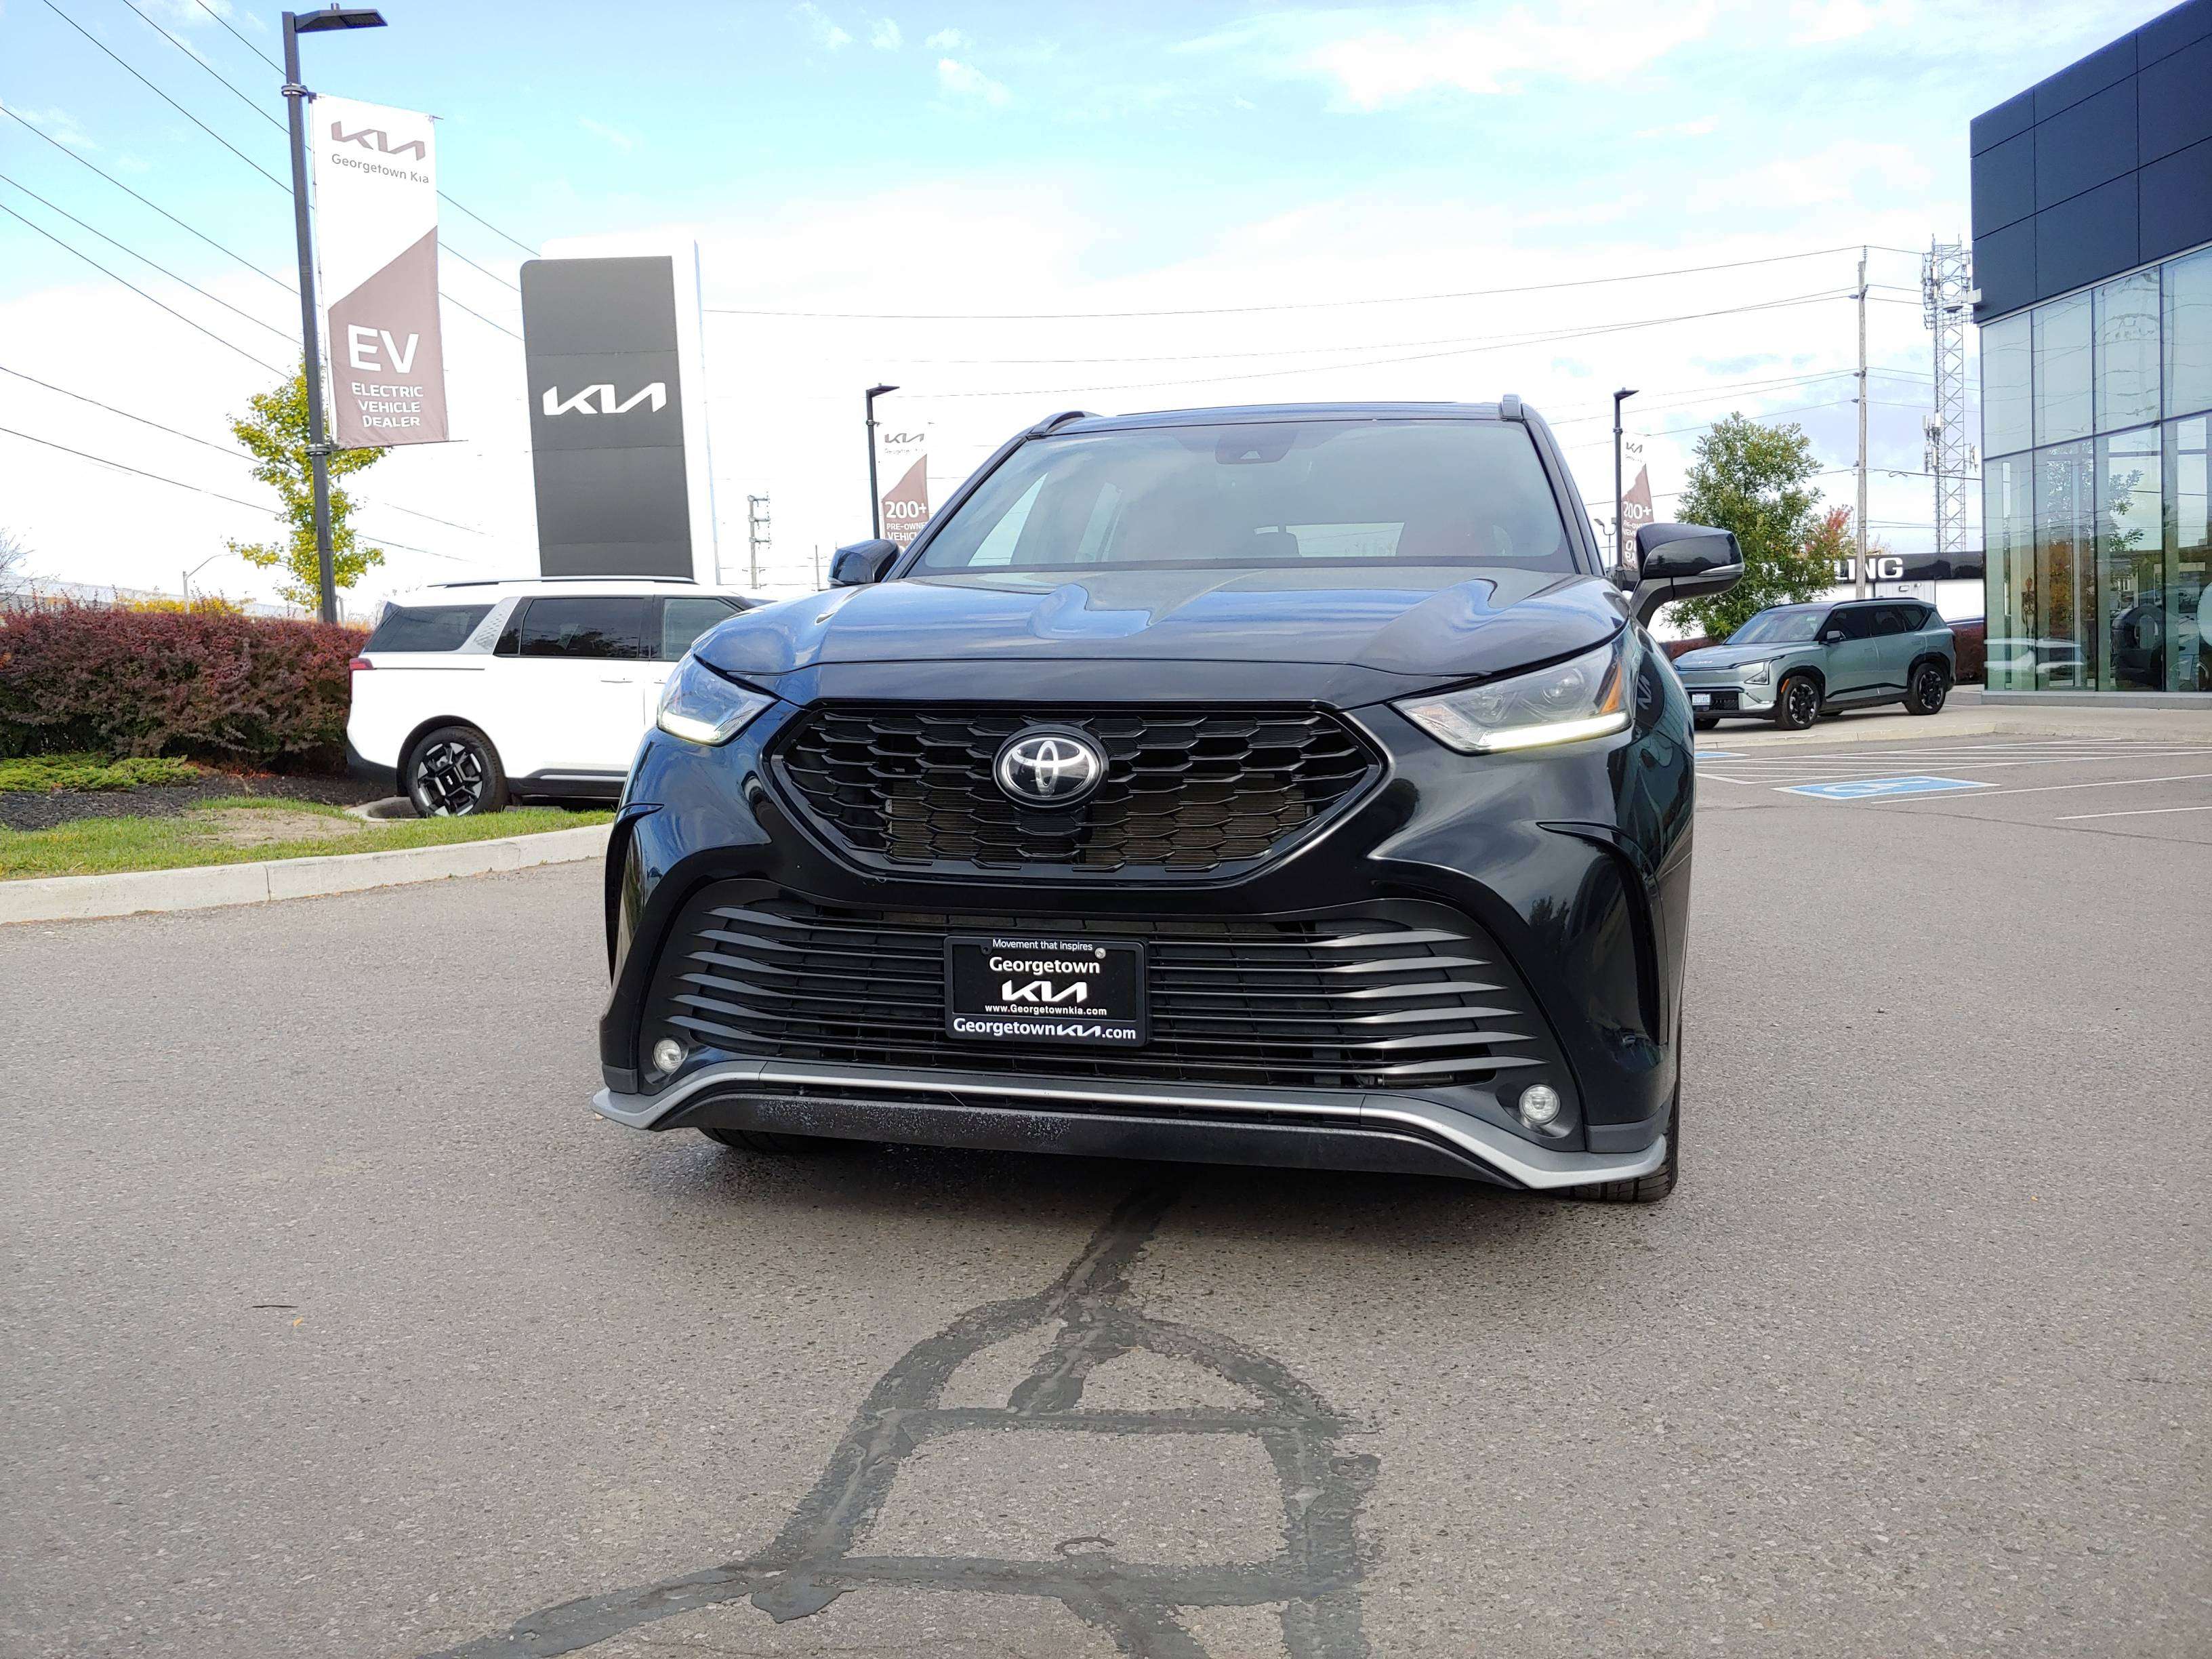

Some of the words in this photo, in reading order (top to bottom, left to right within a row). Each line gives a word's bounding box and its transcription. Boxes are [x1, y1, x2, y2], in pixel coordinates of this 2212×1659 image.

[331, 121, 426, 161] KIA
[331, 153, 407, 180] Georgetown
[411, 171, 429, 184] Kia
[348, 324, 419, 373] EV
[351, 382, 424, 398] ELECTRIC
[358, 399, 421, 413] VEHICLE
[543, 382, 667, 416] KIA
[362, 415, 421, 428] DEALER
[884, 432, 924, 444] KIA
[885, 501, 927, 519] 200+
[886, 522, 928, 531] PRE-OWNE
[992, 939, 1039, 949] Movement
[1040, 941, 1058, 950] that
[1060, 941, 1093, 952] inspires
[989, 956, 1101, 976] Georgetown
[1002, 980, 1088, 1003] KIA
[985, 1004, 1107, 1015] www.Georgetownkia.com
